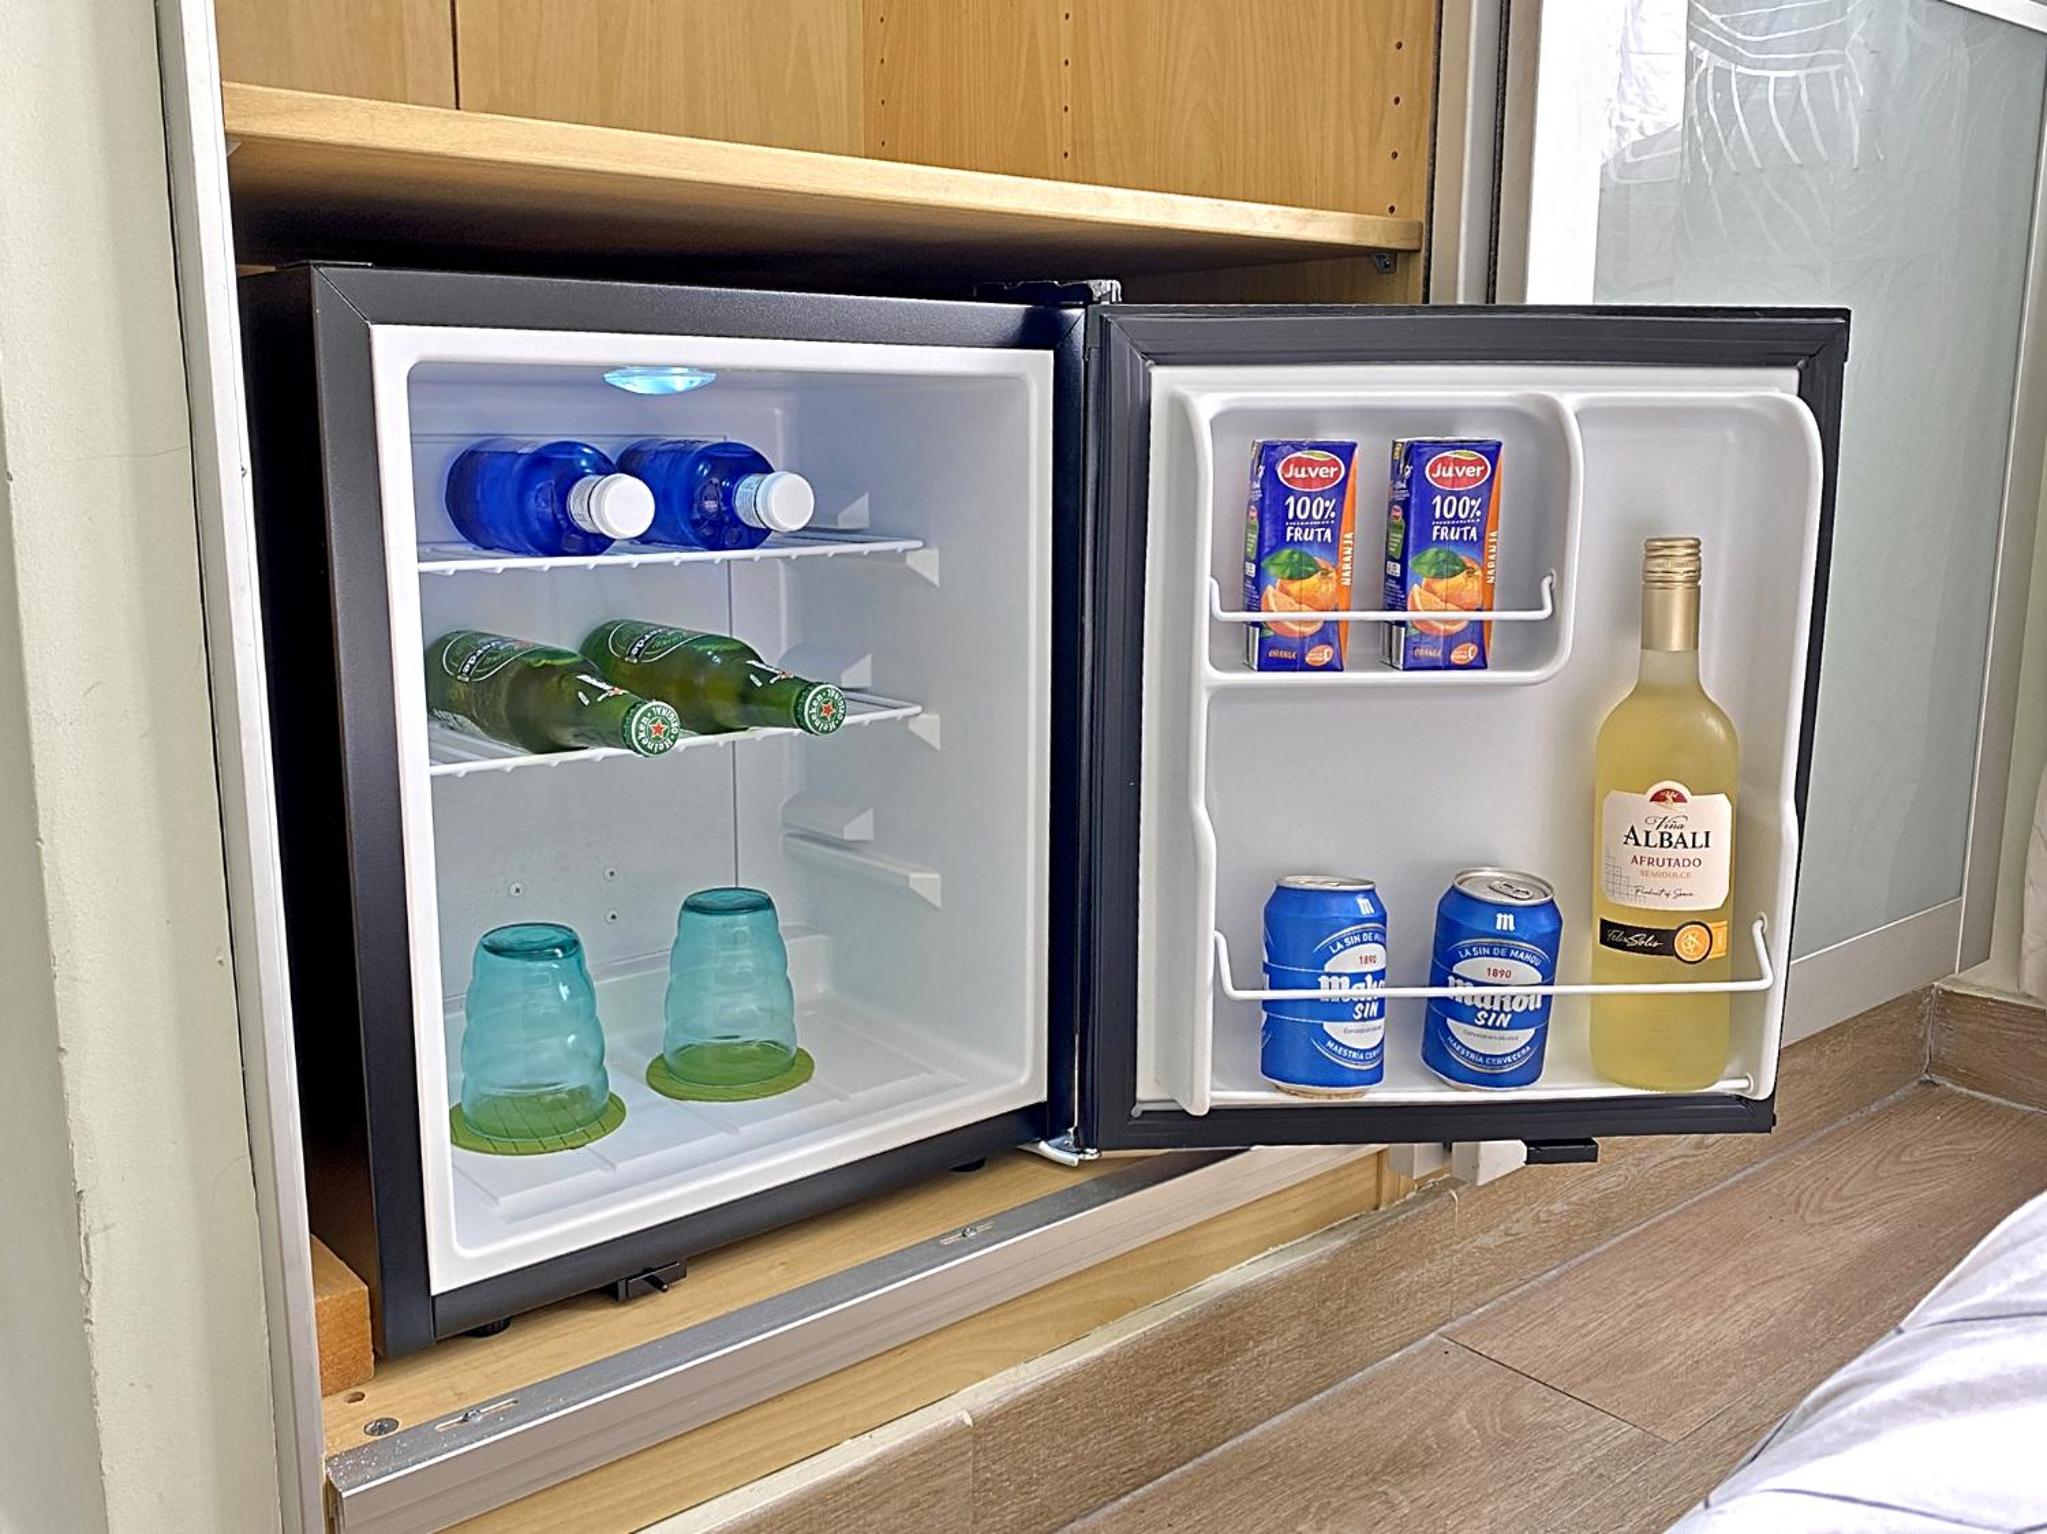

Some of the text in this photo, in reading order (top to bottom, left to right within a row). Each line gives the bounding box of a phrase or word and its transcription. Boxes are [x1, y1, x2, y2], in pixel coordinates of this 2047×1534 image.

[1285, 496, 1337, 520] 100%
[1432, 495, 1482, 519] 100%
[1286, 526, 1332, 543] FRUTA
[1432, 525, 1477, 542] FRUTA
[1341, 531, 1355, 586] NARANJA
[1486, 530, 1499, 585] NARANJA
[637, 717, 673, 753] Heineken
[1645, 815, 1688, 831] Viña
[1623, 825, 1711, 849] ALBALI
[1631, 855, 1702, 868] AFRUTADO
[1330, 941, 1344, 953] LA
[1344, 934, 1361, 948] SIN
[1362, 932, 1374, 942] DE
[1359, 955, 1377, 966] 1890
[1458, 947, 1542, 967] LA SIN DE MAHOU
[1486, 967, 1512, 979] 1890
[1353, 1002, 1378, 1020] SIN
[1474, 1011, 1513, 1028] SIN
[1485, 1045, 1532, 1066] CERVECERA
